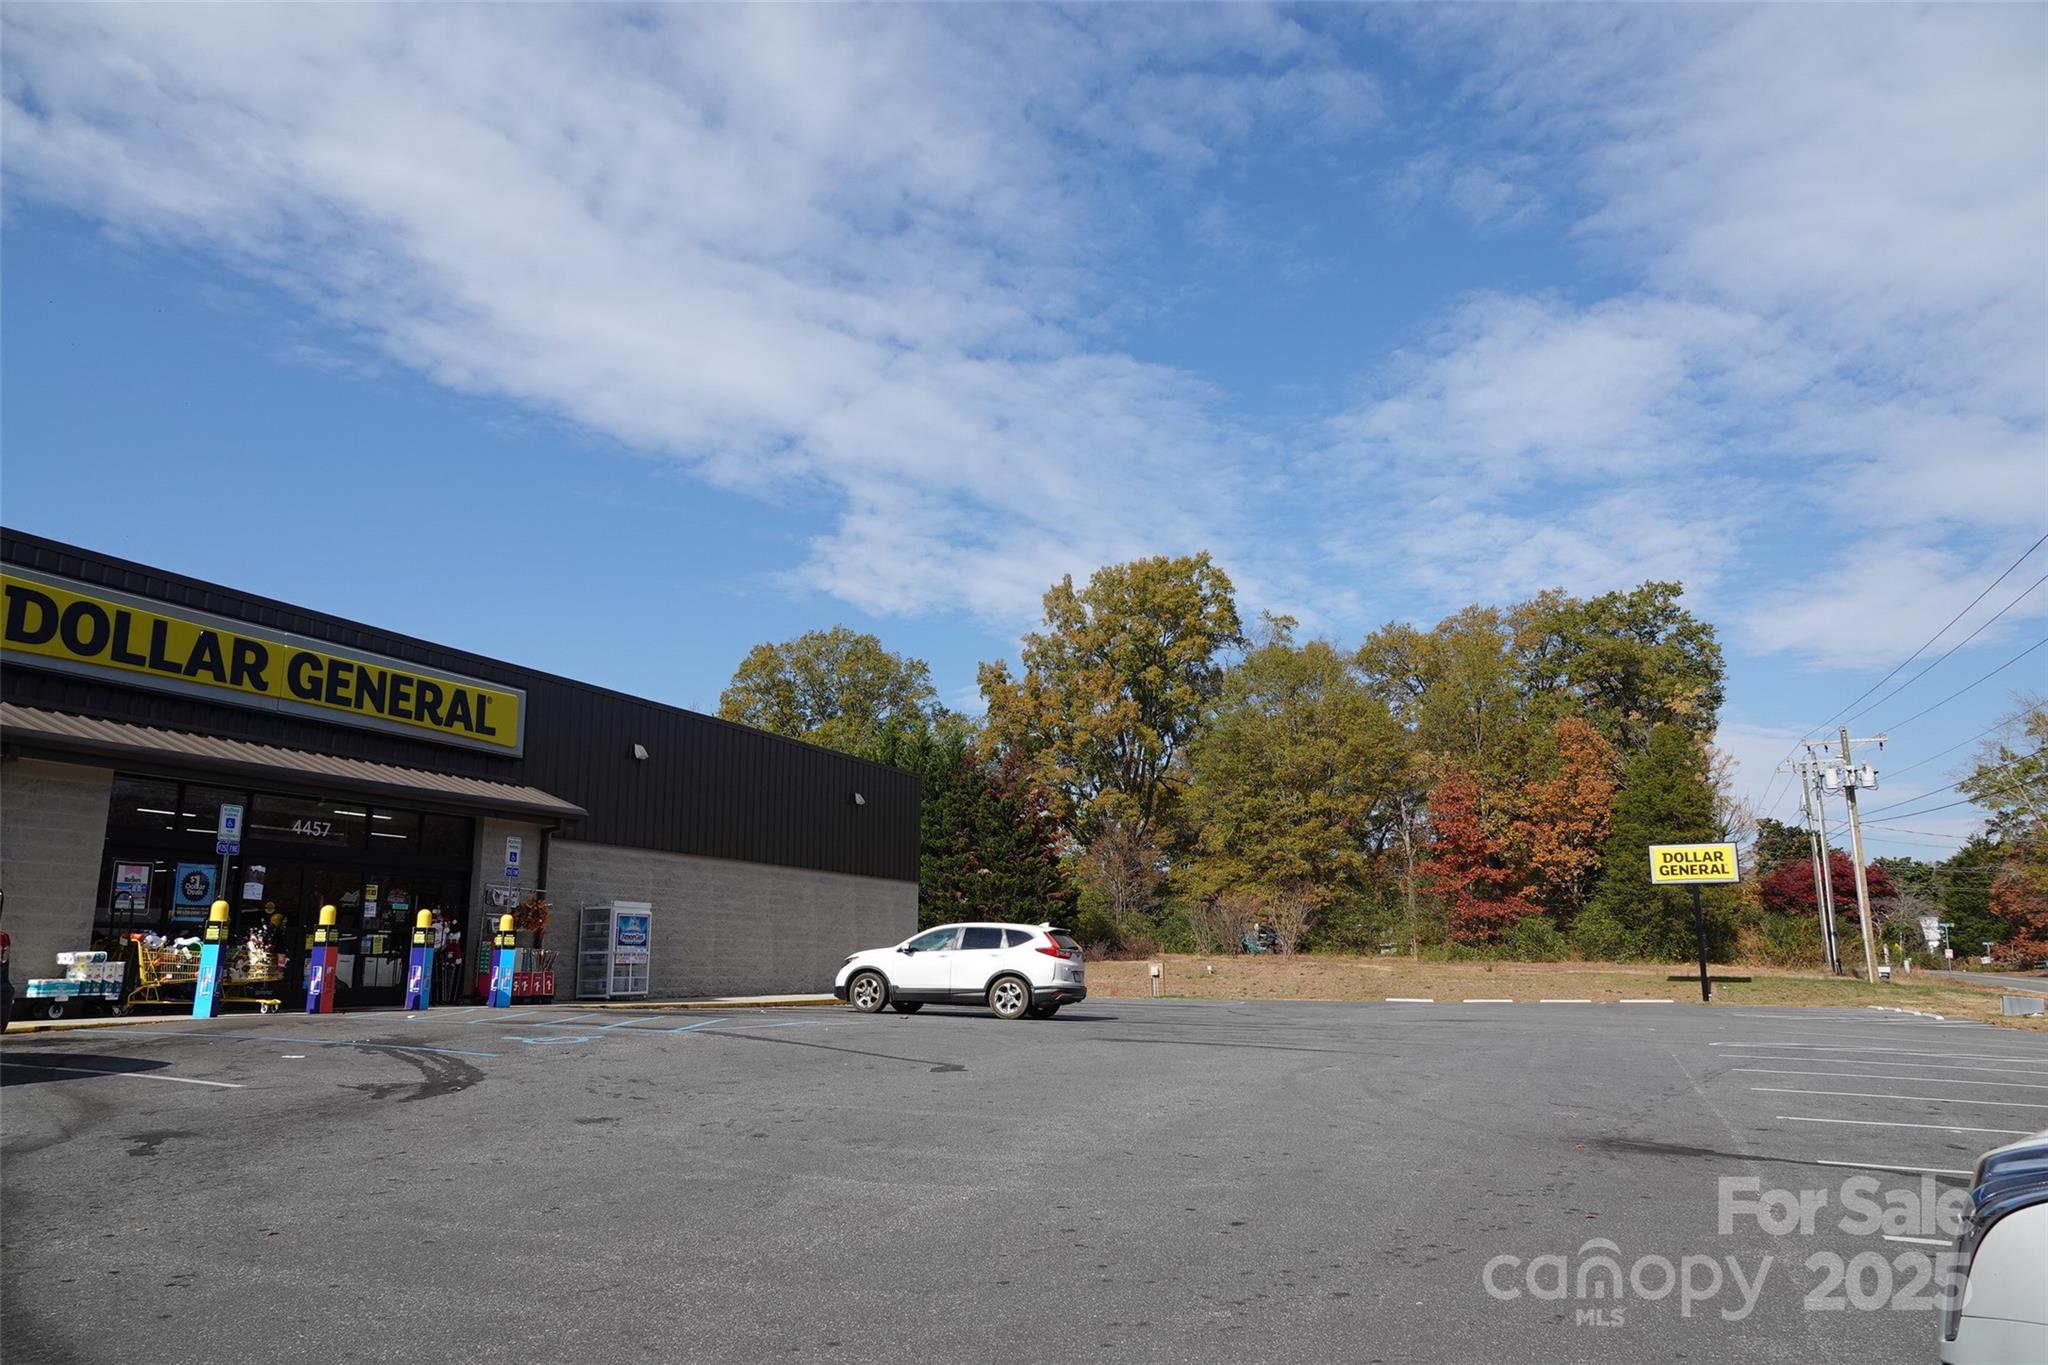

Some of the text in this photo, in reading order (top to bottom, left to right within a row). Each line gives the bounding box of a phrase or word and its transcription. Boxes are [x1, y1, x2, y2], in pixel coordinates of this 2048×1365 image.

[5, 585, 496, 736] DOLLAR GENERAL
[292, 819, 331, 838] 4457
[1662, 851, 1724, 863] DOLLAR
[1659, 864, 1730, 876] GENERAL
[185, 883, 206, 892] Dollar
